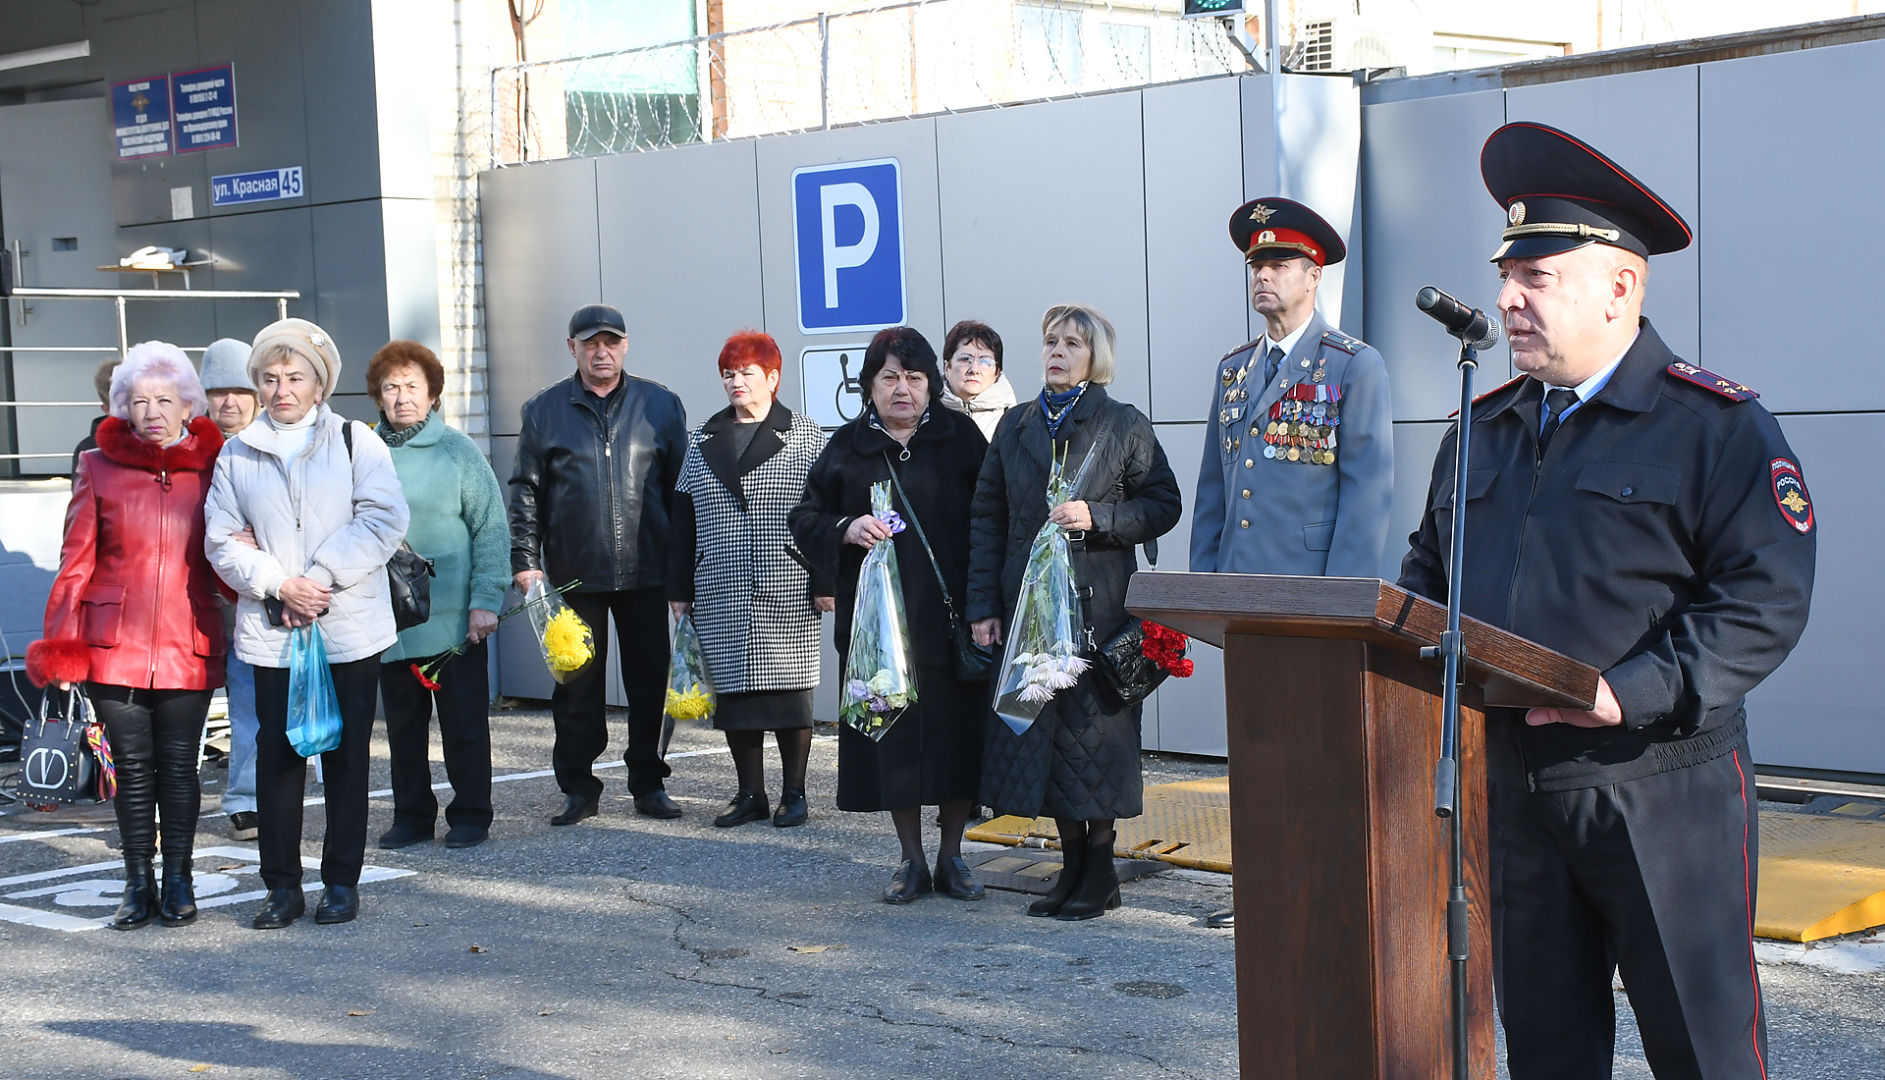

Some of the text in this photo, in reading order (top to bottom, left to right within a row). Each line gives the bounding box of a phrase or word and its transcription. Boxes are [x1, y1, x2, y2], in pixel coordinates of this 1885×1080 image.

[214, 170, 300, 201] ул. Красная 45
[820, 182, 879, 308] P
[1776, 476, 1802, 490] РОССИЯ
